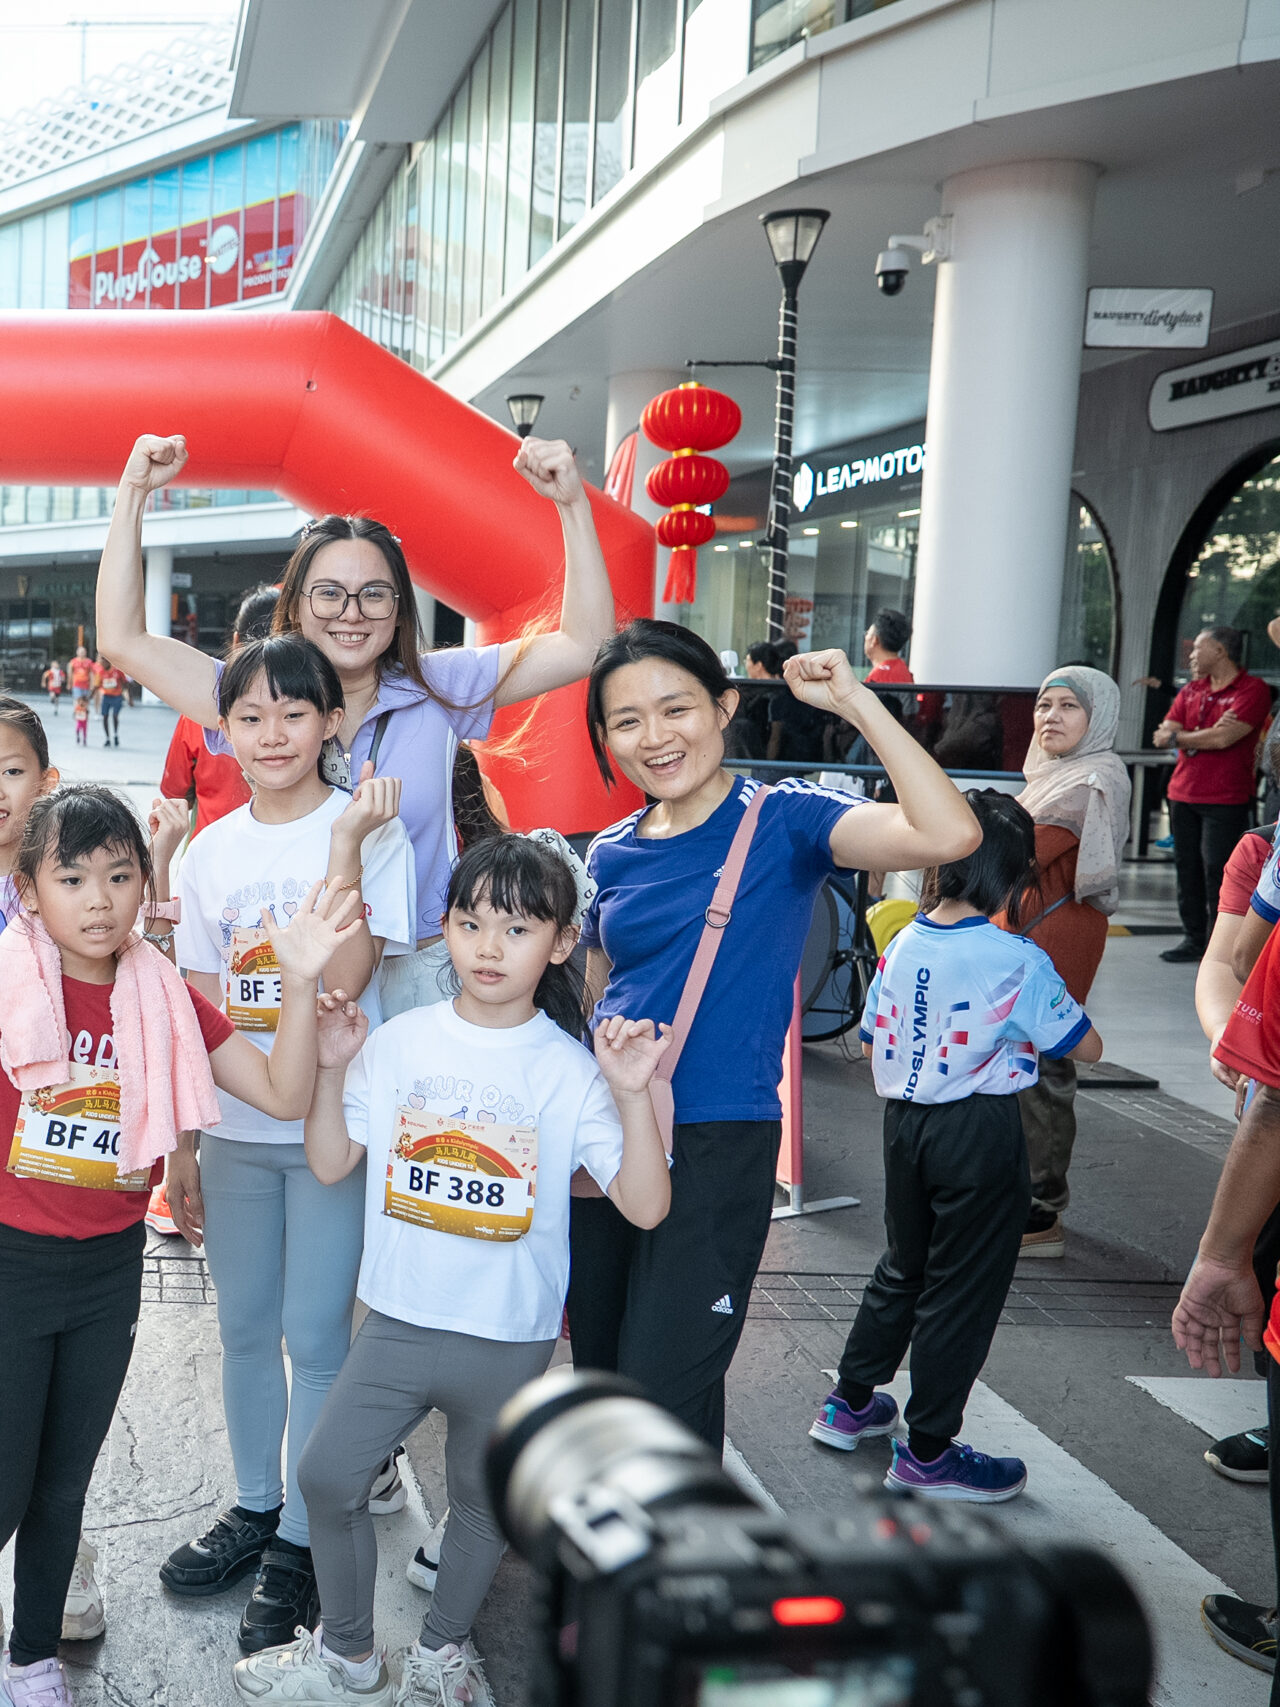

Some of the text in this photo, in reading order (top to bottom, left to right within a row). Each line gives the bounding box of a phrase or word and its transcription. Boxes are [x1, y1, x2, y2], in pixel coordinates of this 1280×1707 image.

[240, 979, 264, 1002] BF
[46, 1120, 87, 1149] BF
[409, 1165, 505, 1207] BF 388
